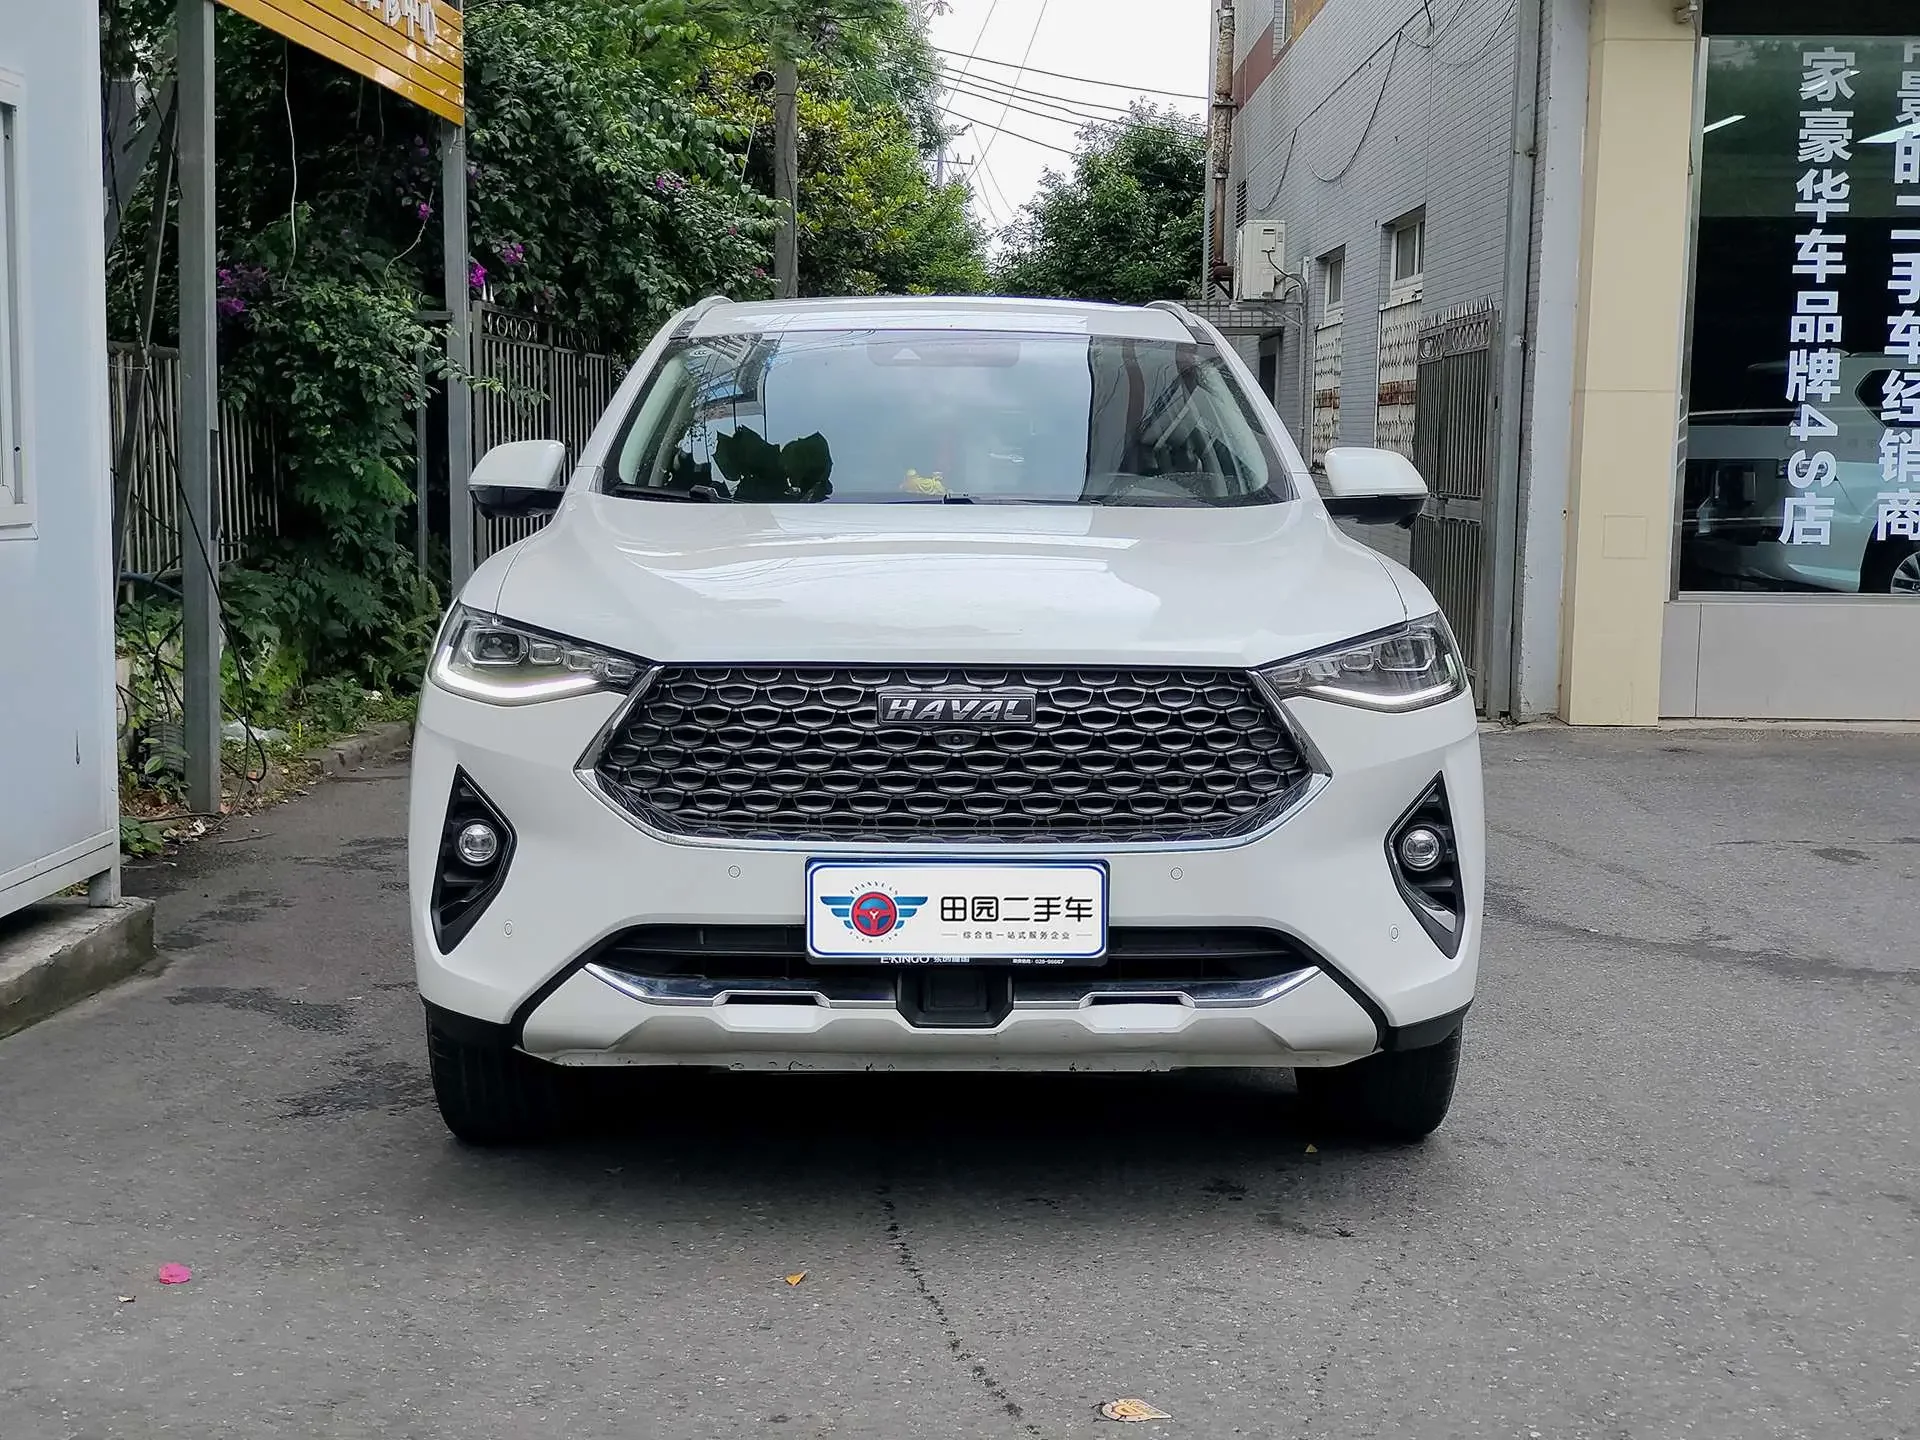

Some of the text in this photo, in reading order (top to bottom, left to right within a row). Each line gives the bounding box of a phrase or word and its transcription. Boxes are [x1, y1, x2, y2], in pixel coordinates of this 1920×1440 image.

[1778, 47, 1855, 545] 家豪华车品牌4S店
[885, 699, 1029, 721] HAVAL
[940, 896, 1094, 923] 田园二手车
[963, 931, 1070, 940] 综合性一站式服务企业
